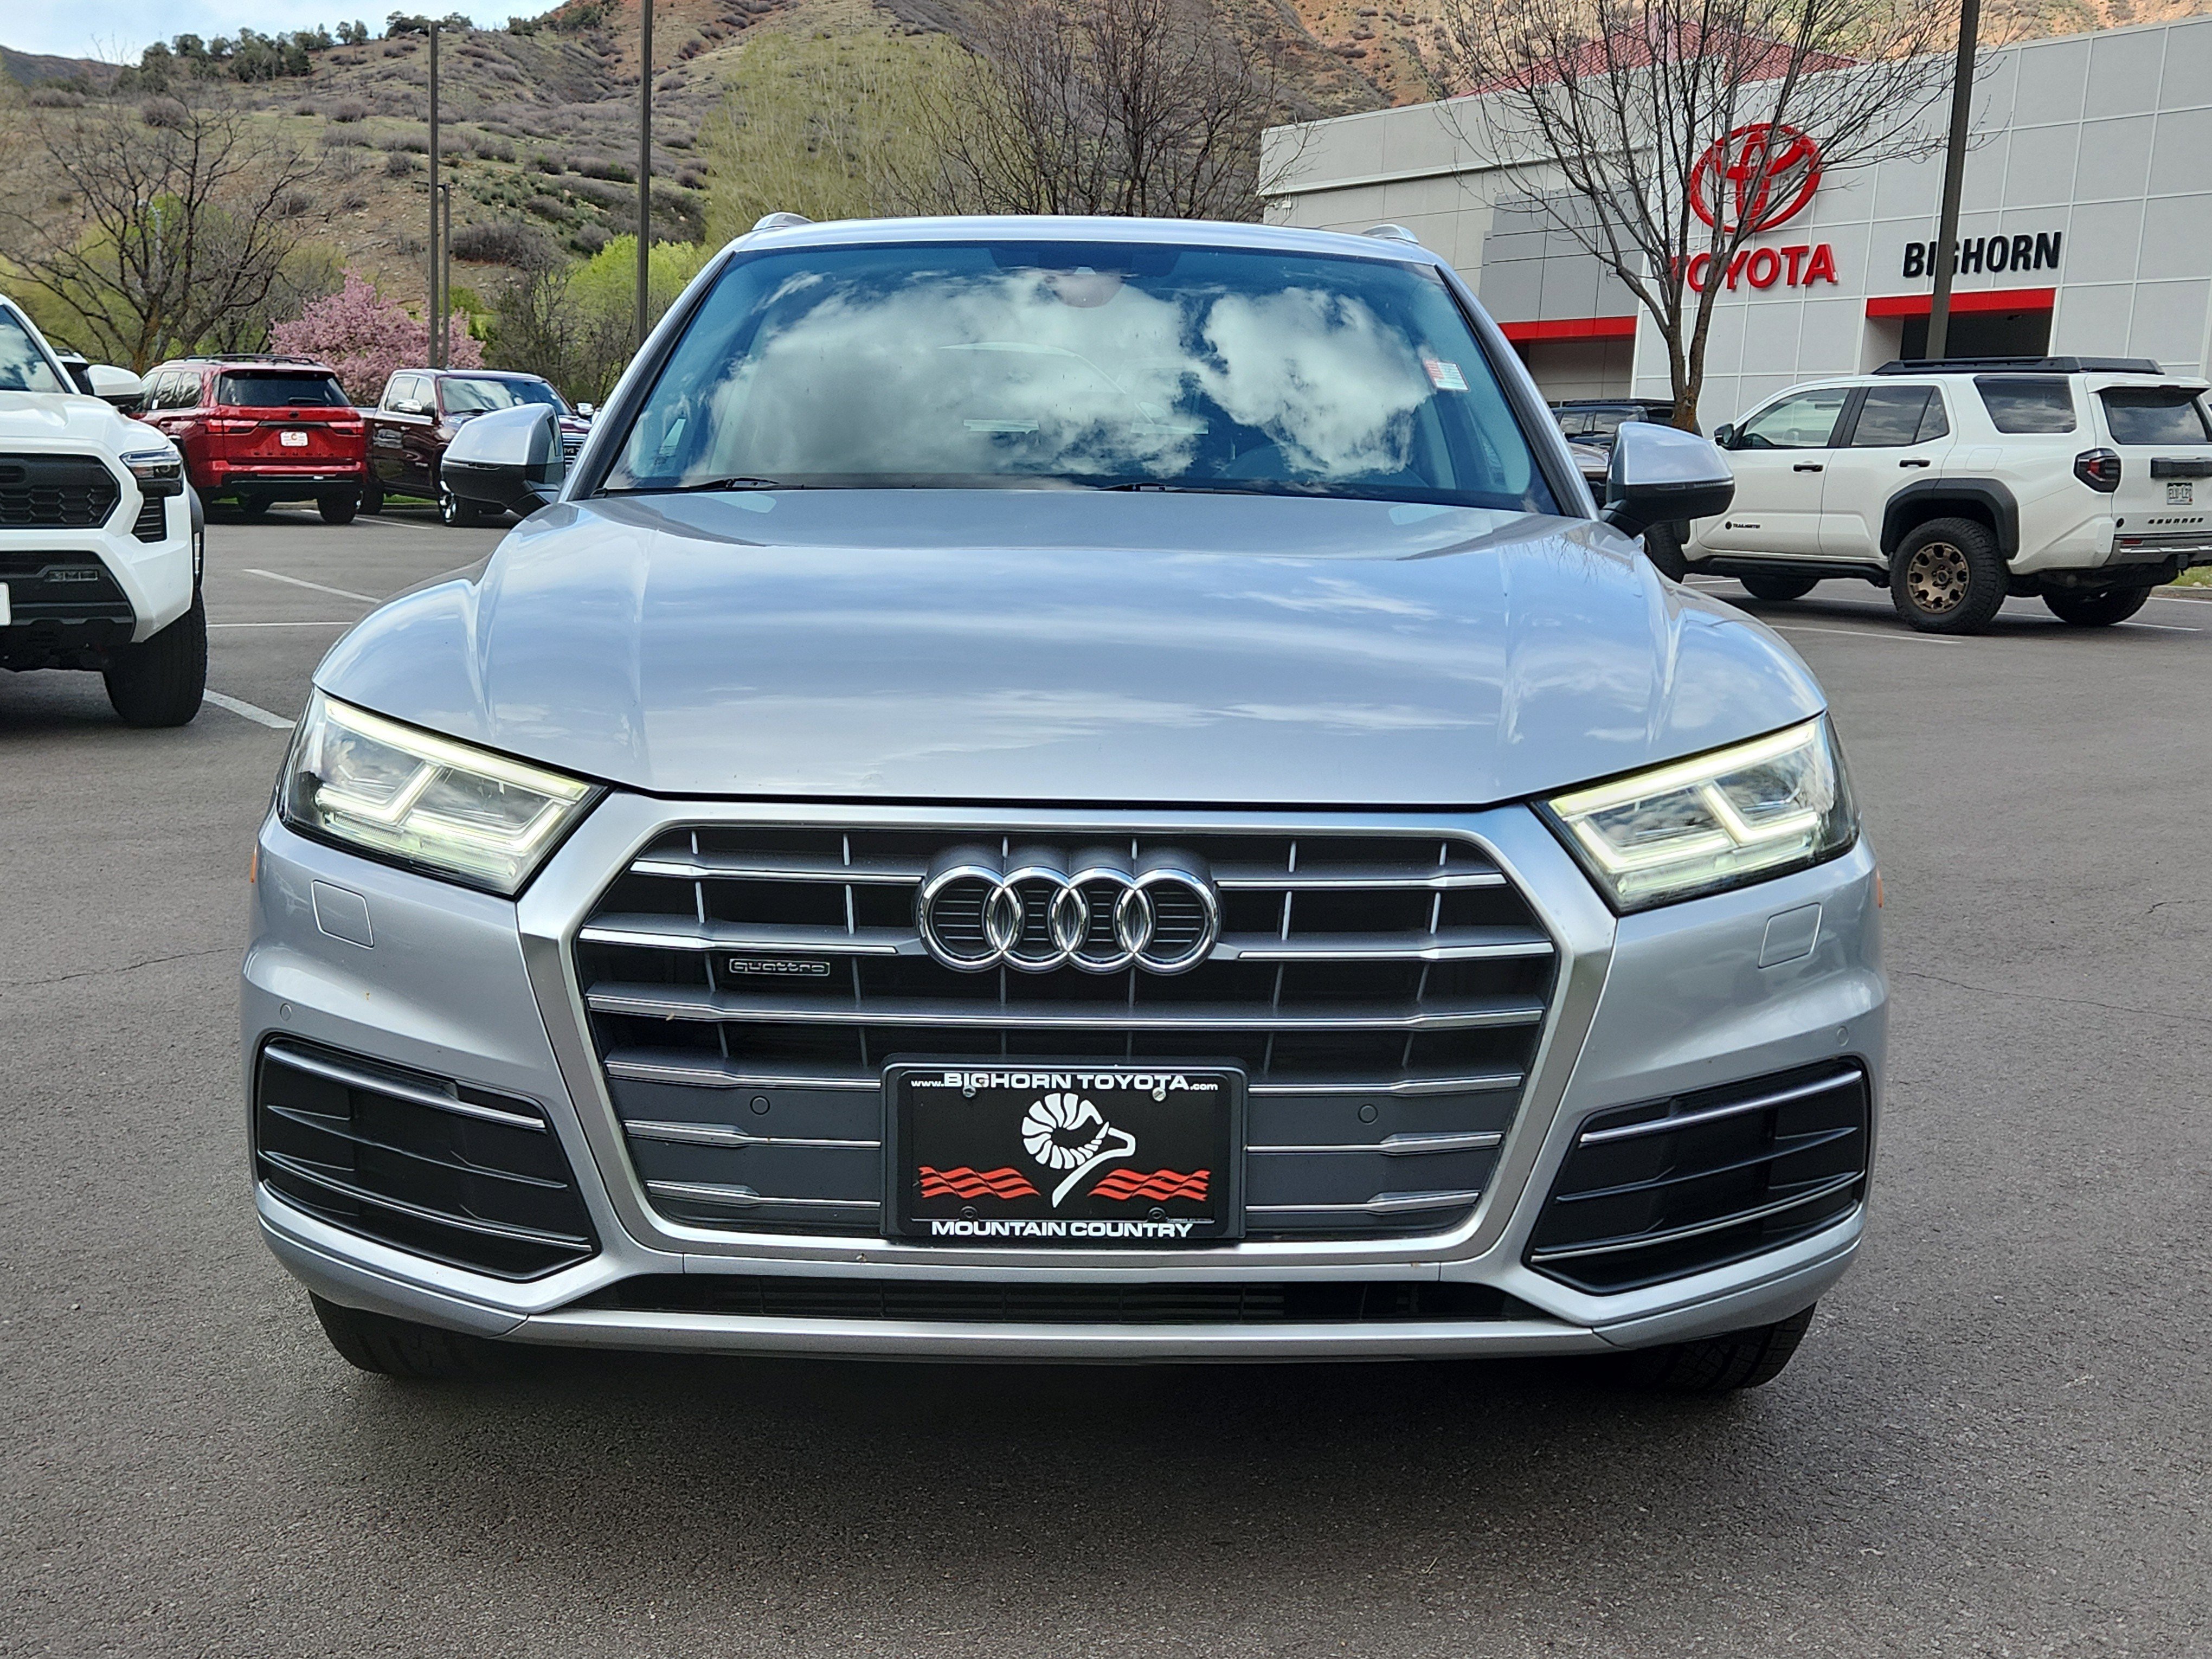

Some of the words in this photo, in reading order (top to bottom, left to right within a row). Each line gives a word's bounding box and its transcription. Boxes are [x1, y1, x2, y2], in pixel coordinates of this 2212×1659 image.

[734, 962, 825, 972] quattro
[931, 1221, 1066, 1237] MOUNTAIN
[1071, 1222, 1194, 1238] COUNTRY
